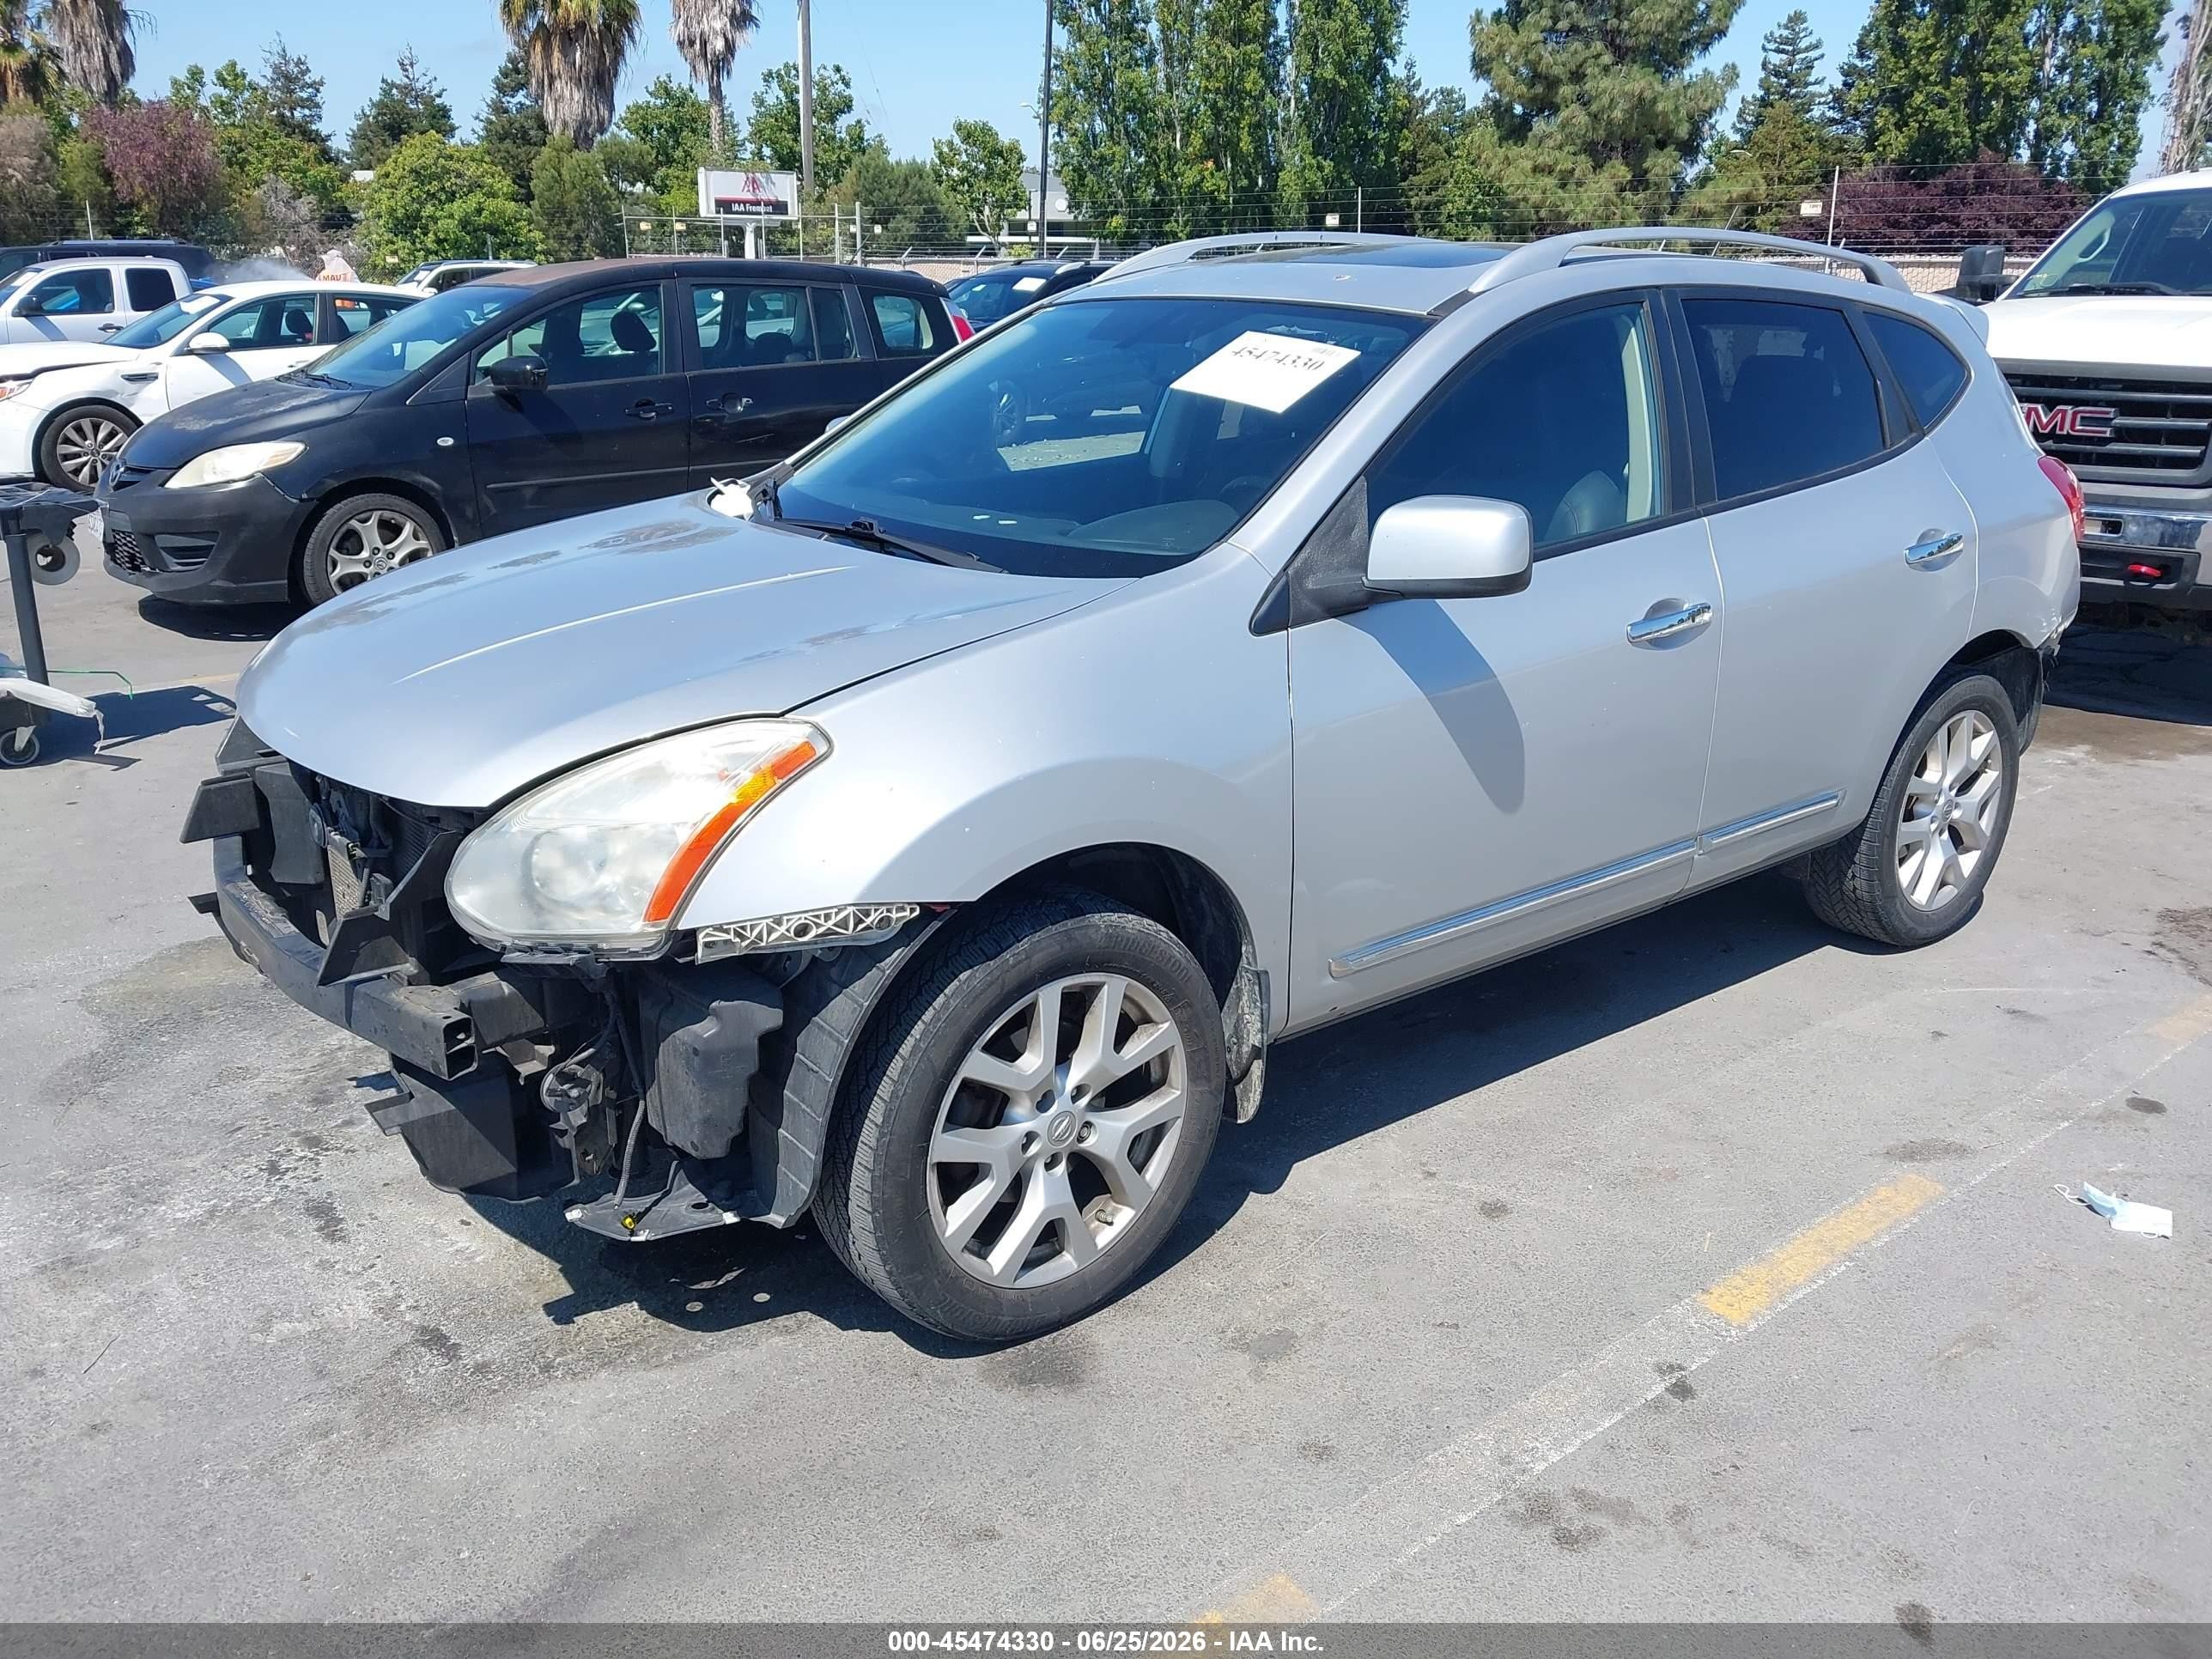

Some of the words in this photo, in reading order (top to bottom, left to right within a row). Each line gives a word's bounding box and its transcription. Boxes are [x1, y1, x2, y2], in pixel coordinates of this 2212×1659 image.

[731, 203, 744, 212] IAA
[1231, 346, 1326, 371] 45474330
[2020, 403, 2118, 438] MC
